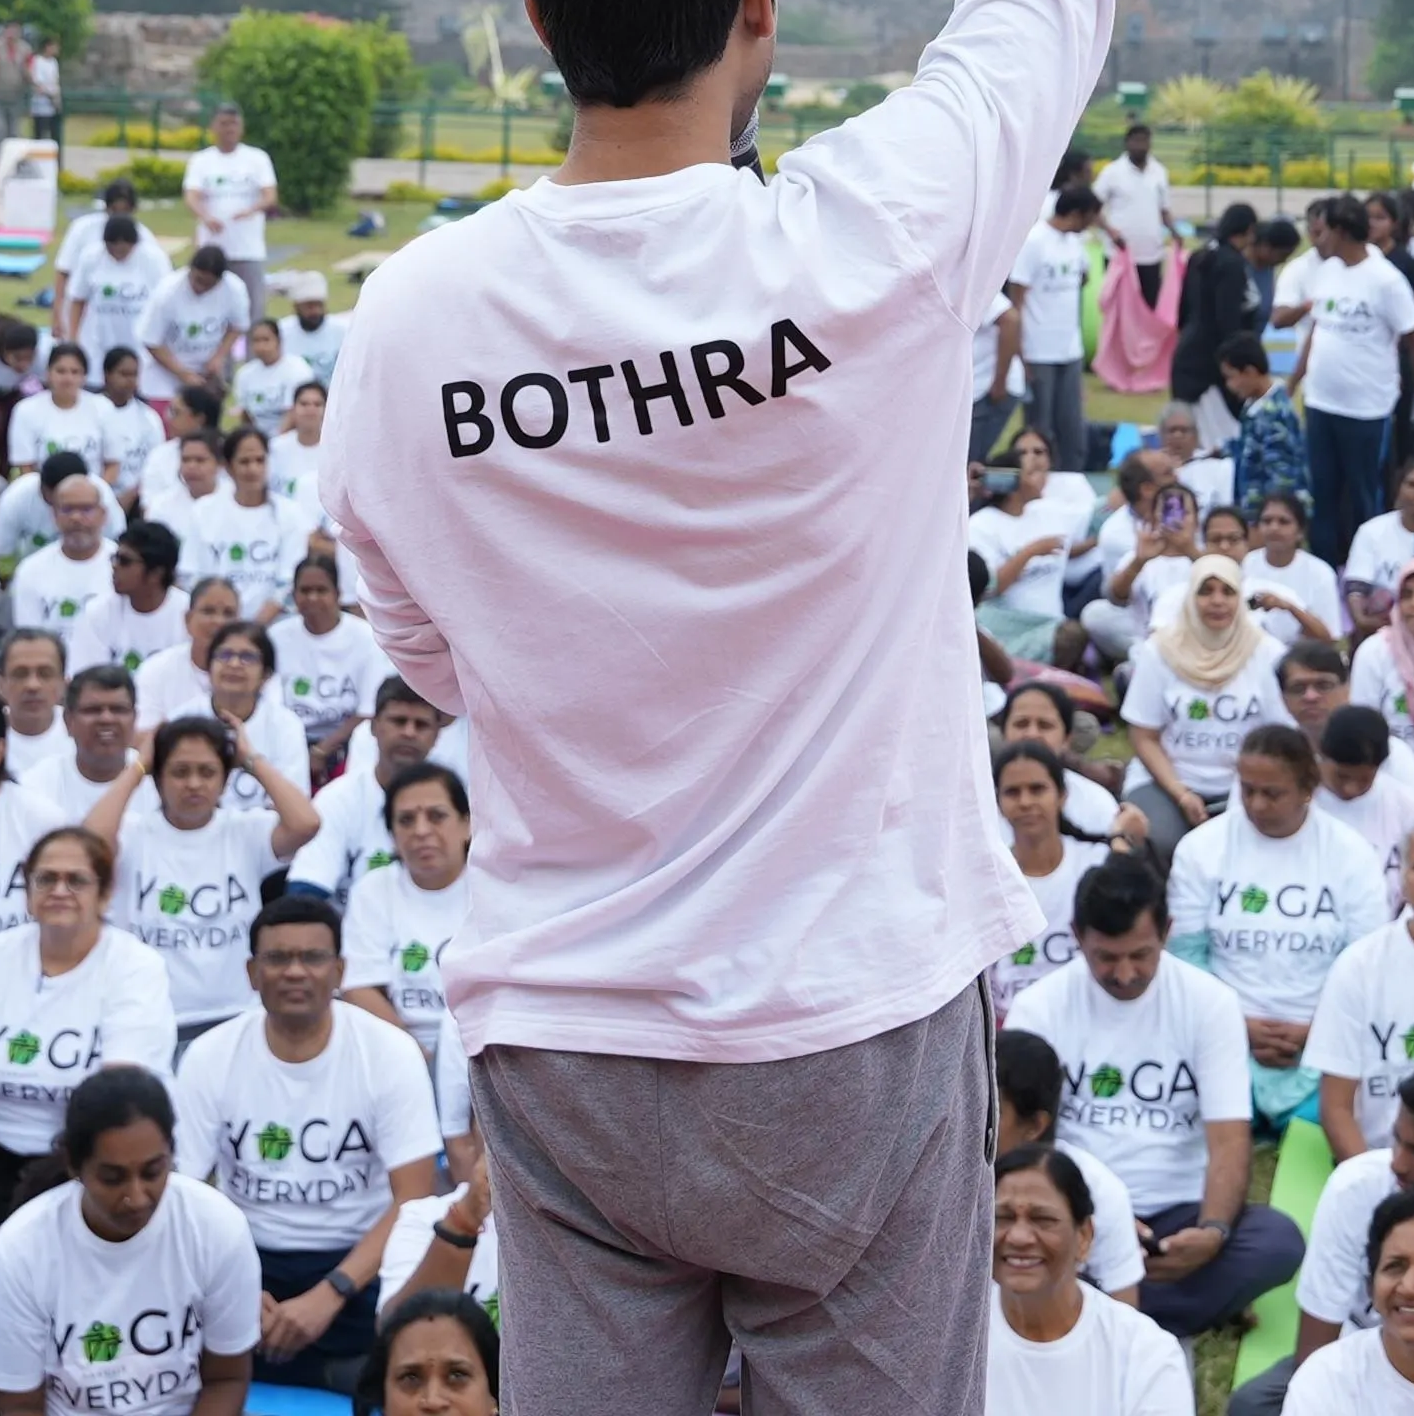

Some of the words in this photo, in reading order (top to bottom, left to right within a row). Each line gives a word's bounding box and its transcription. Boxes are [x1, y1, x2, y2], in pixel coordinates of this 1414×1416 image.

[442, 318, 831, 457] BOTHRA
[135, 874, 250, 919] YOGA
[1217, 880, 1340, 921] YOGA
[1060, 1060, 1200, 1102] YOGA
[220, 1117, 372, 1163] YOGA
[51, 1301, 203, 1364] YOGA
